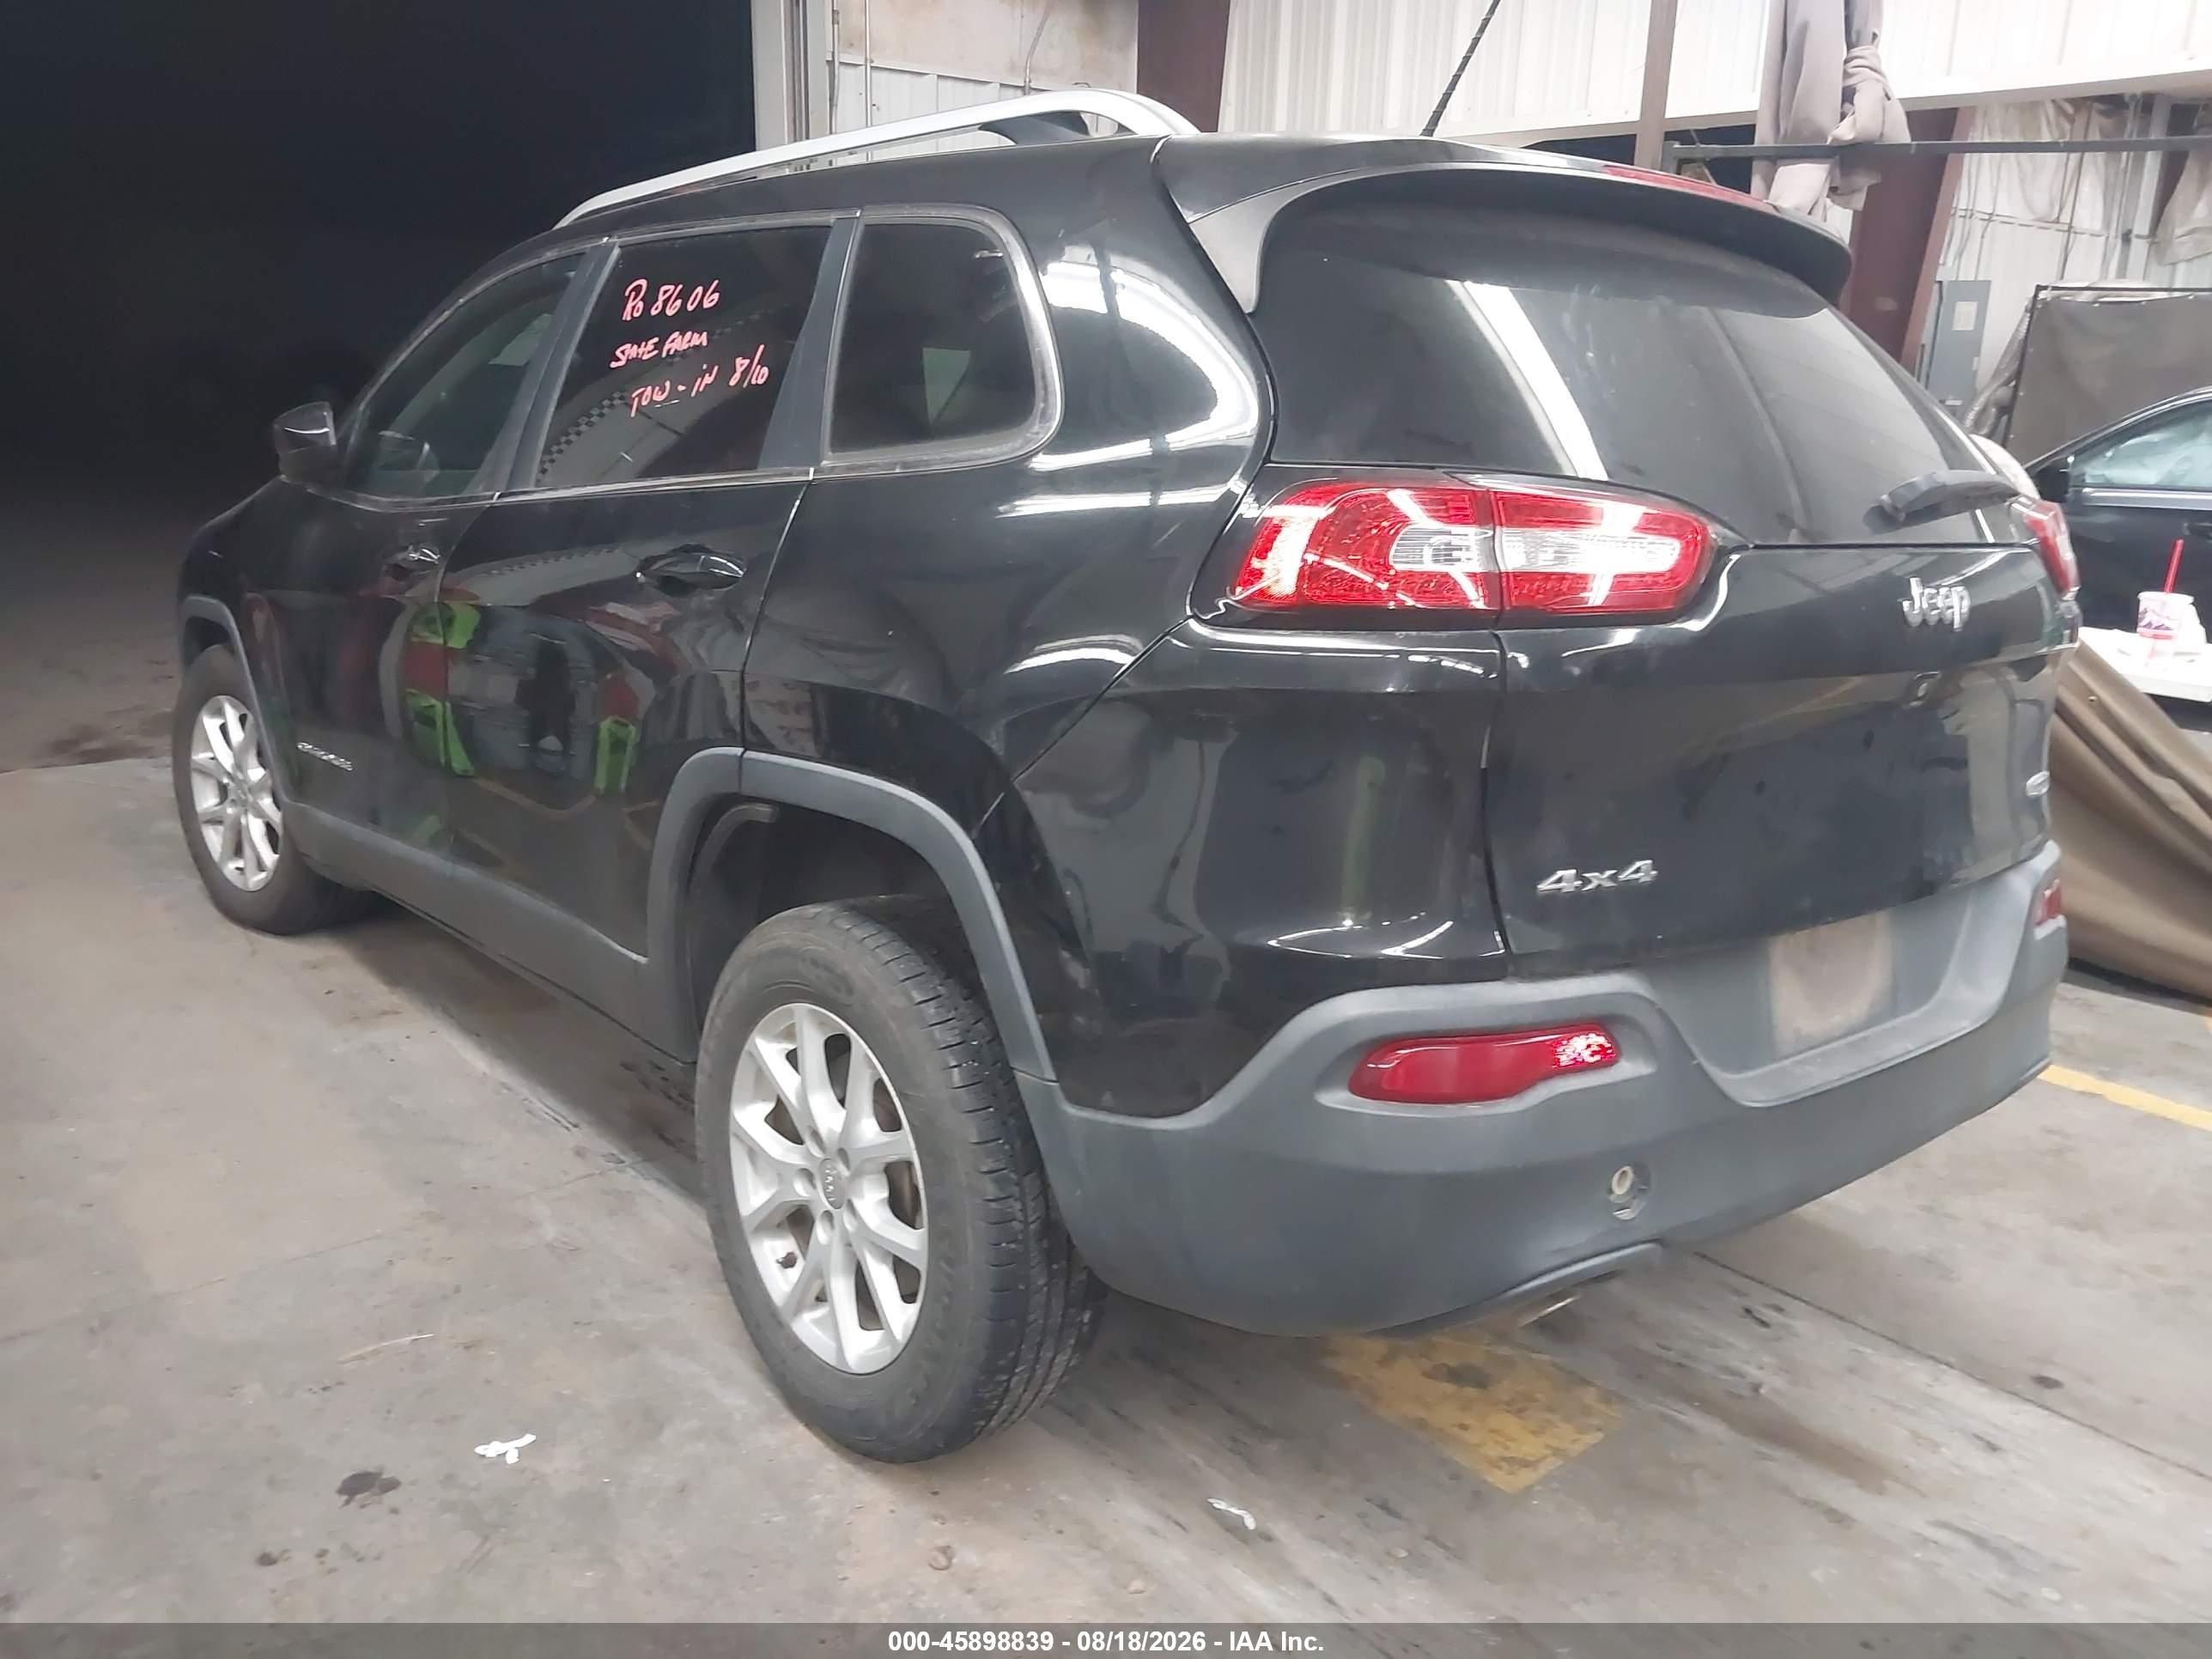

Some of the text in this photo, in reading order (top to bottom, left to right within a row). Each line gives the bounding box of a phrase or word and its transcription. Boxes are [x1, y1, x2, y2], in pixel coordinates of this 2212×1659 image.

[650, 279, 720, 316] 8606
[661, 331, 708, 357] FARM
[728, 343, 769, 388] 8/10
[1902, 577, 1971, 629] Jeep
[1536, 860, 1658, 893] 4x4
